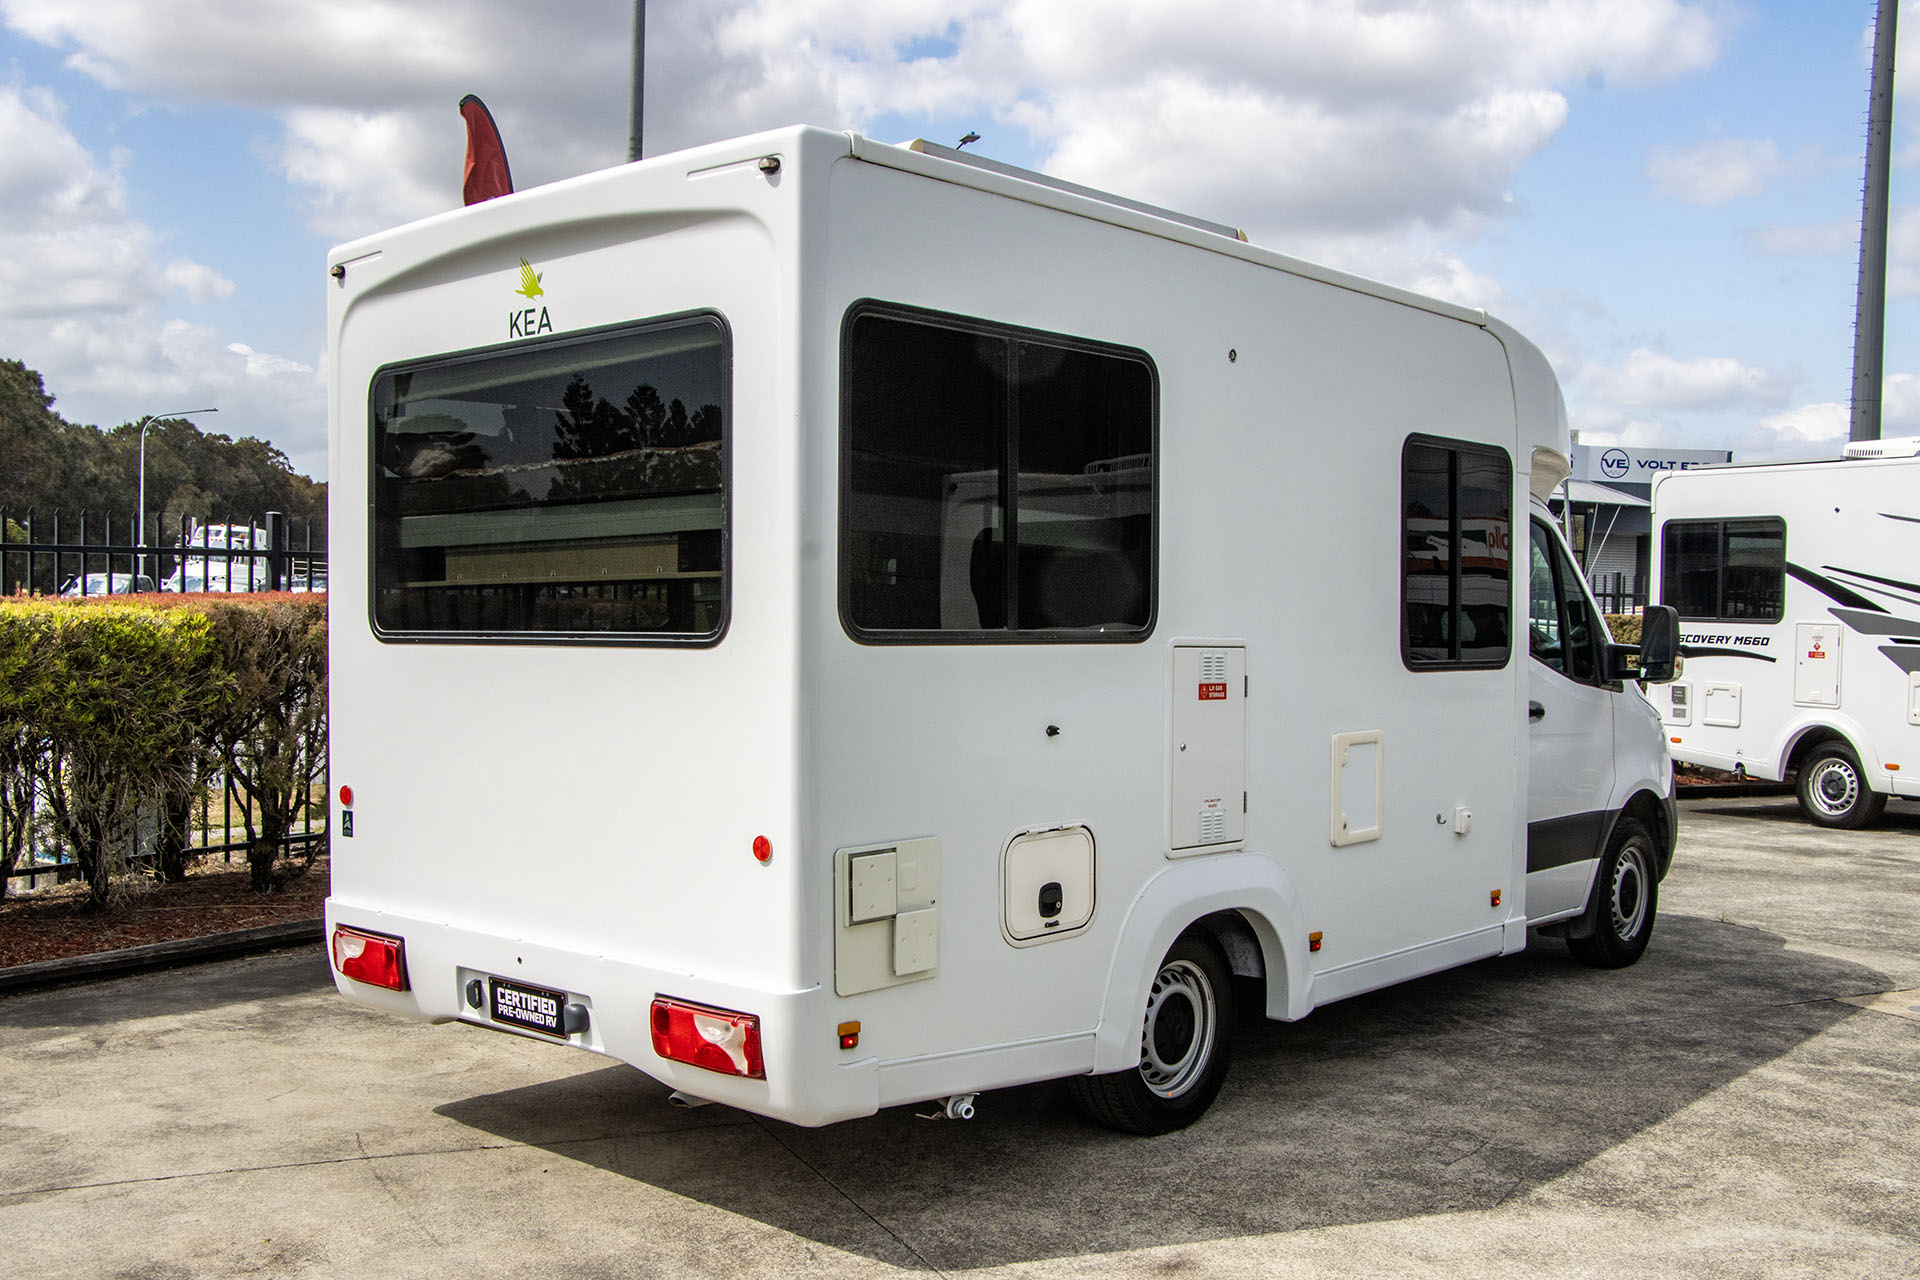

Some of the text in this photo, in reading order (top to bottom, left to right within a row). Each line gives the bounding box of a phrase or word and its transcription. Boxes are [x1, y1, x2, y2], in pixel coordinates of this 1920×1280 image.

[509, 306, 552, 339] KEA
[1602, 458, 1628, 469] VE
[1637, 460, 1677, 470] VOLT
[1679, 634, 1770, 646] SCOVERY M660
[496, 987, 557, 1016] CERTIFIED
[498, 1003, 557, 1028] PRE-OWNED RV
